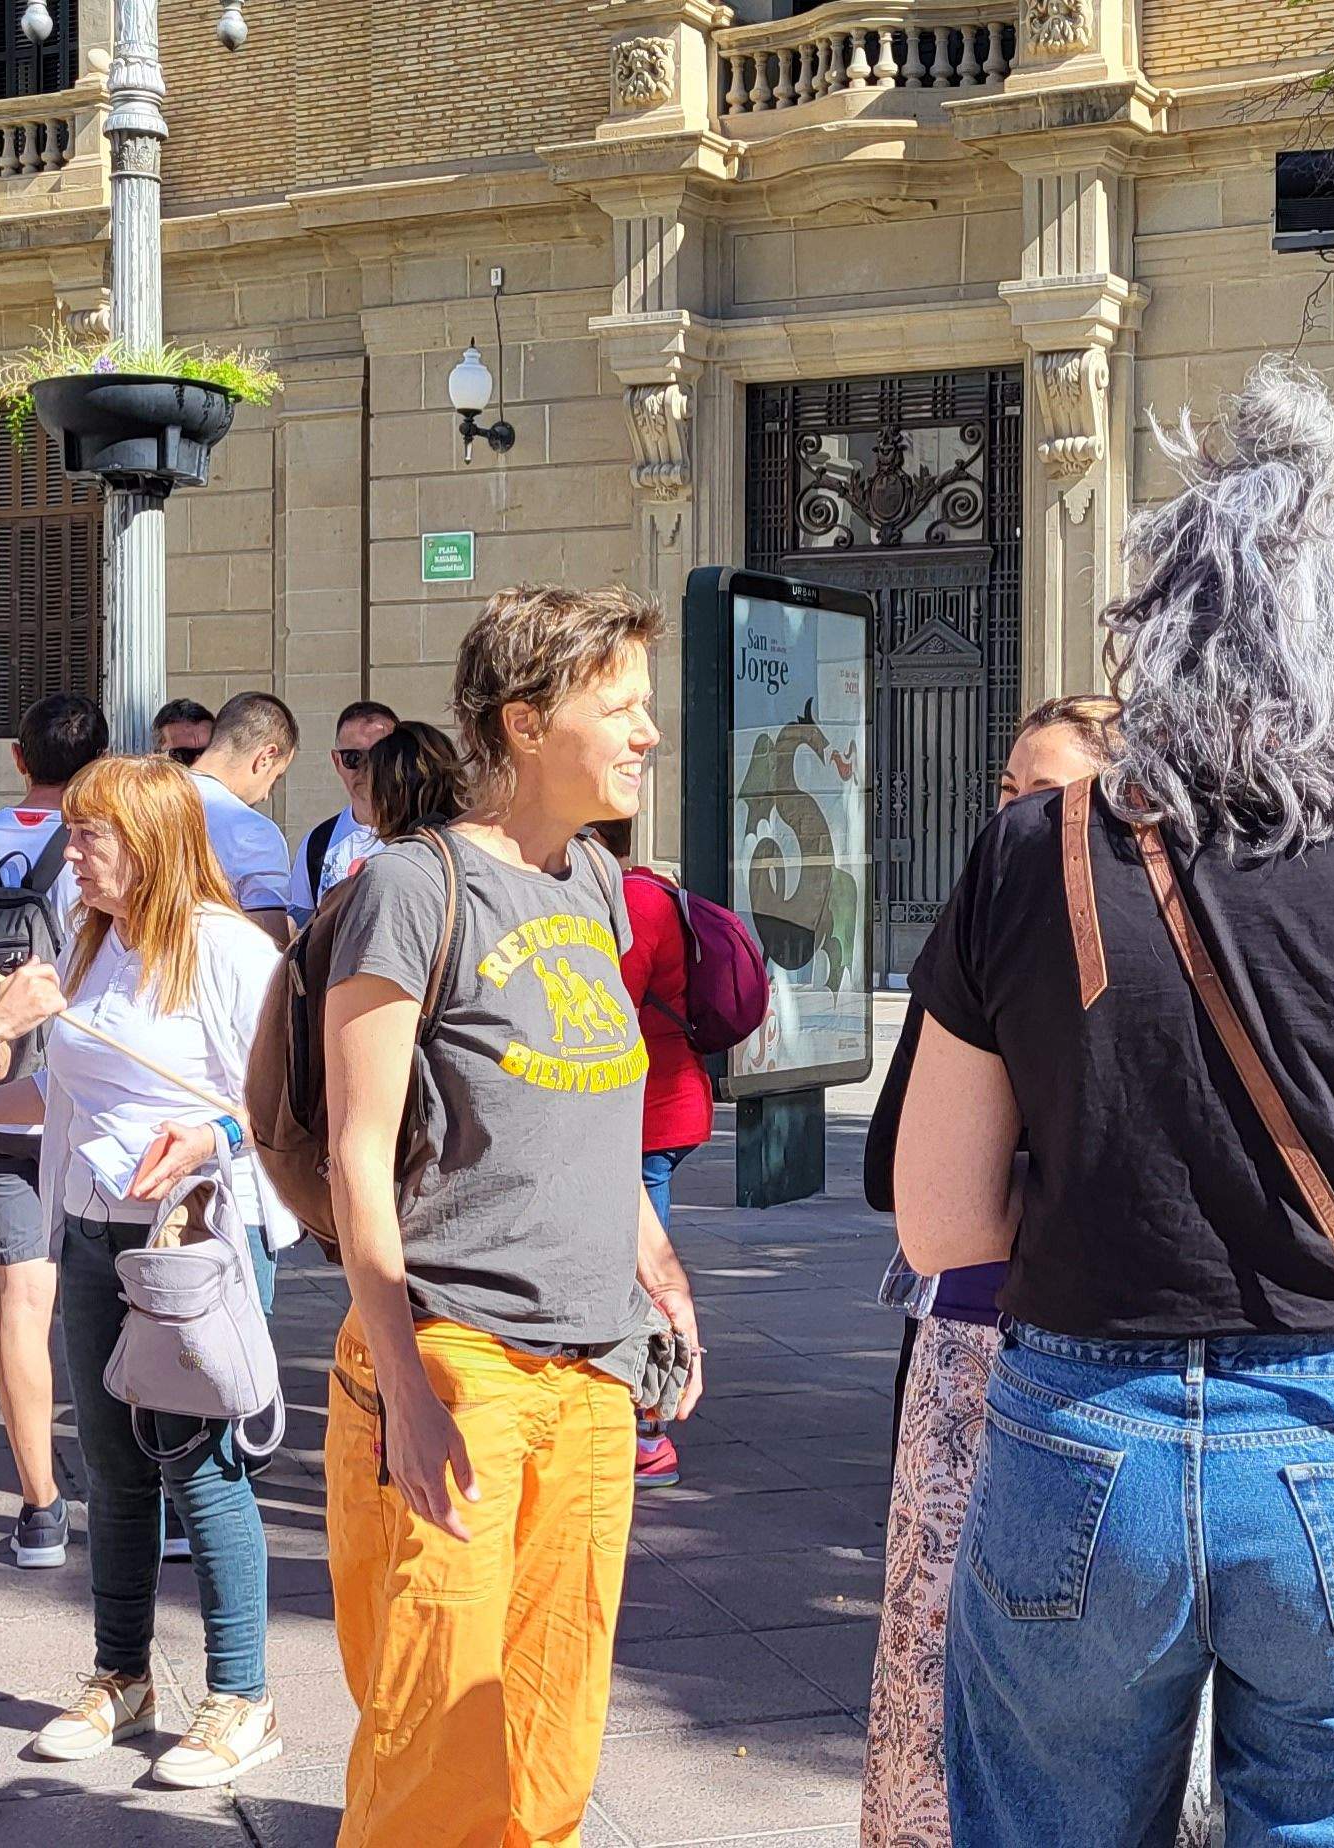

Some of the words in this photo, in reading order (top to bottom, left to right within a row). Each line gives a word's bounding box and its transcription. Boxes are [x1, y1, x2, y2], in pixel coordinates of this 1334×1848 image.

[792, 585, 817, 599] URBAN
[747, 627, 768, 651] San
[736, 646, 789, 696] Jorge
